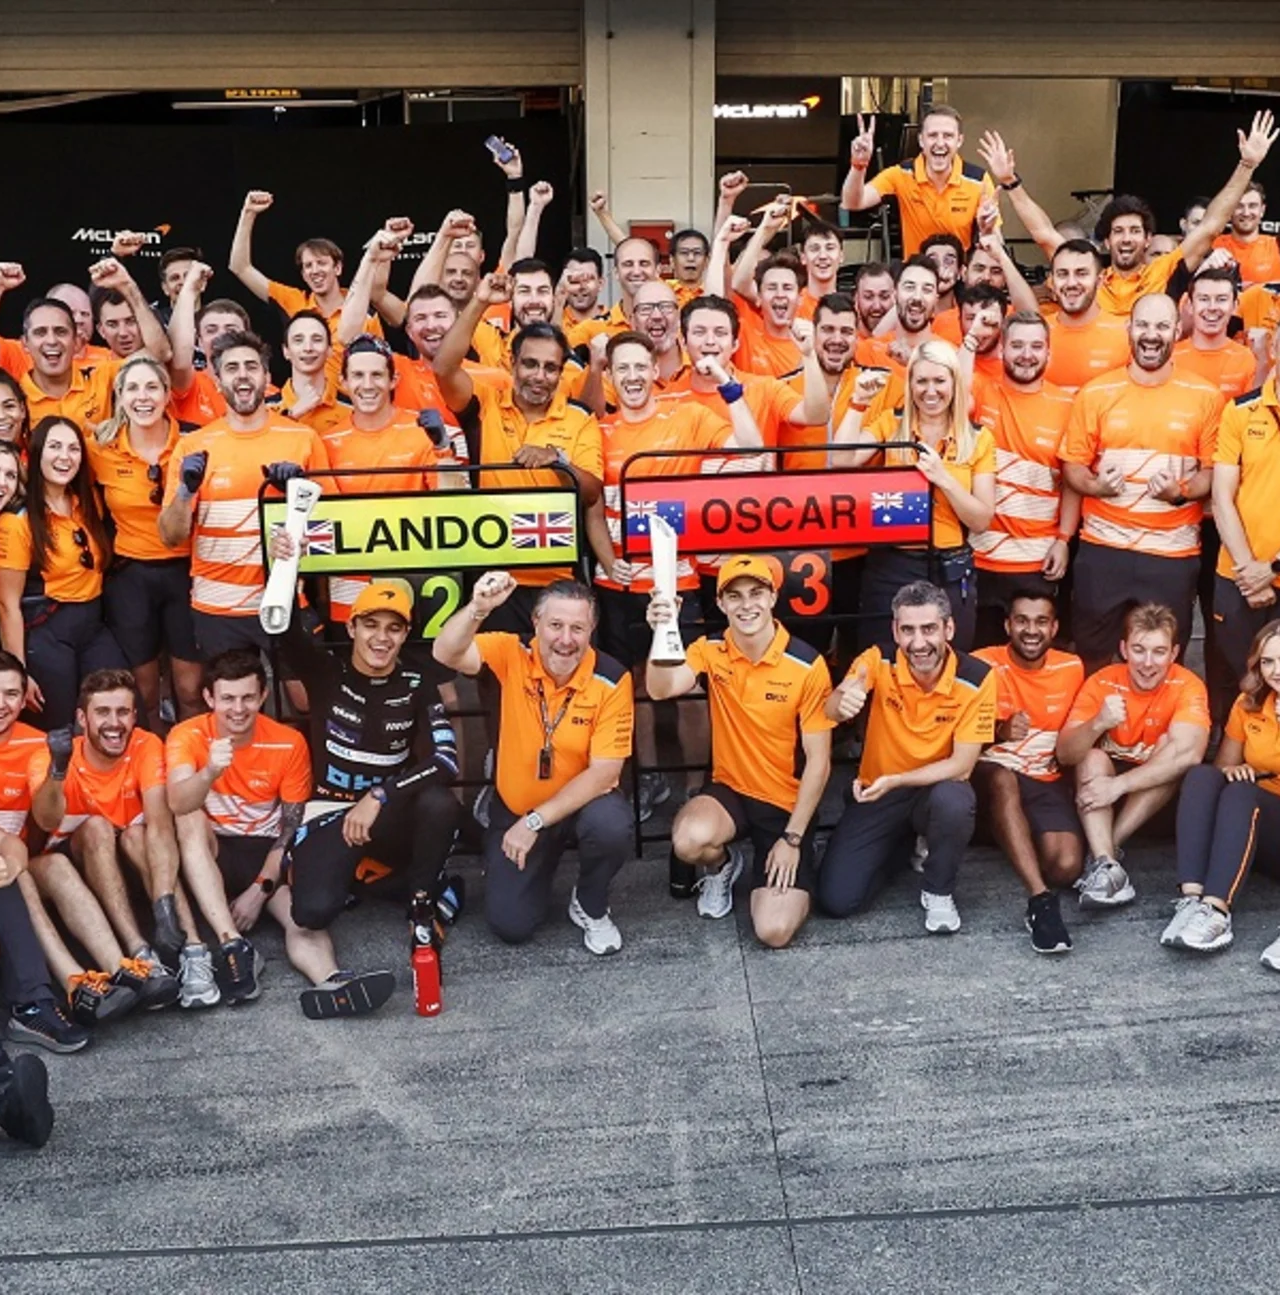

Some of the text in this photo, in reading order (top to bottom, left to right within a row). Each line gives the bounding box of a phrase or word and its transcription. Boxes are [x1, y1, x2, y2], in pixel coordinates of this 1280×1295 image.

[71, 227, 161, 244] McLn
[334, 513, 509, 555] LANDO
[701, 494, 858, 534] OSCAR
